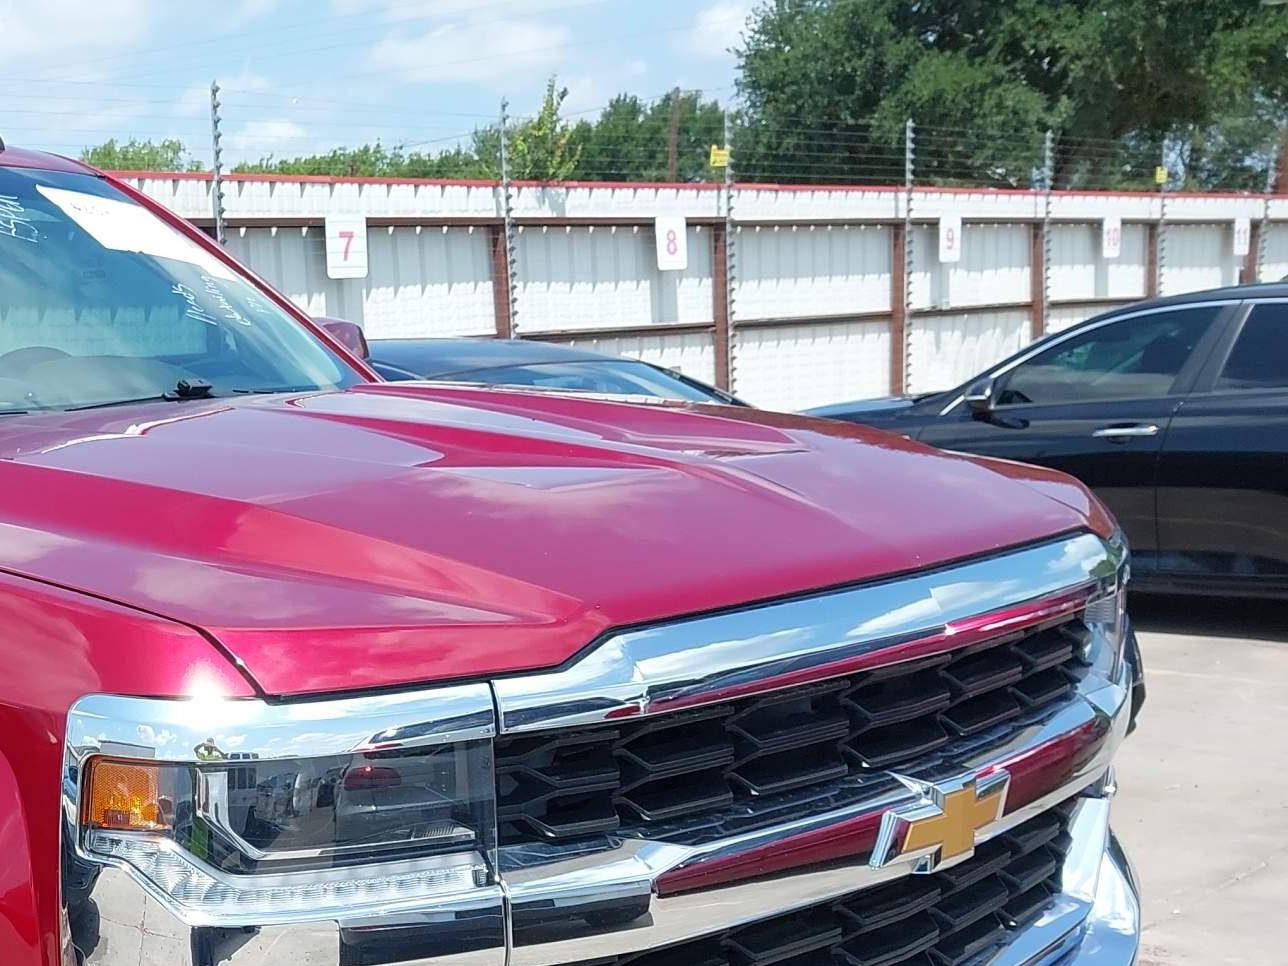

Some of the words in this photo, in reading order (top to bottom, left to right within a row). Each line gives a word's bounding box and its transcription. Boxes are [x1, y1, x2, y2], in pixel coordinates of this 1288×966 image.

[338, 231, 355, 261] 7
[666, 229, 678, 256] 8
[946, 227, 955, 250] 9
[1106, 227, 1120, 247] 10
[1236, 228, 1249, 246] 11
